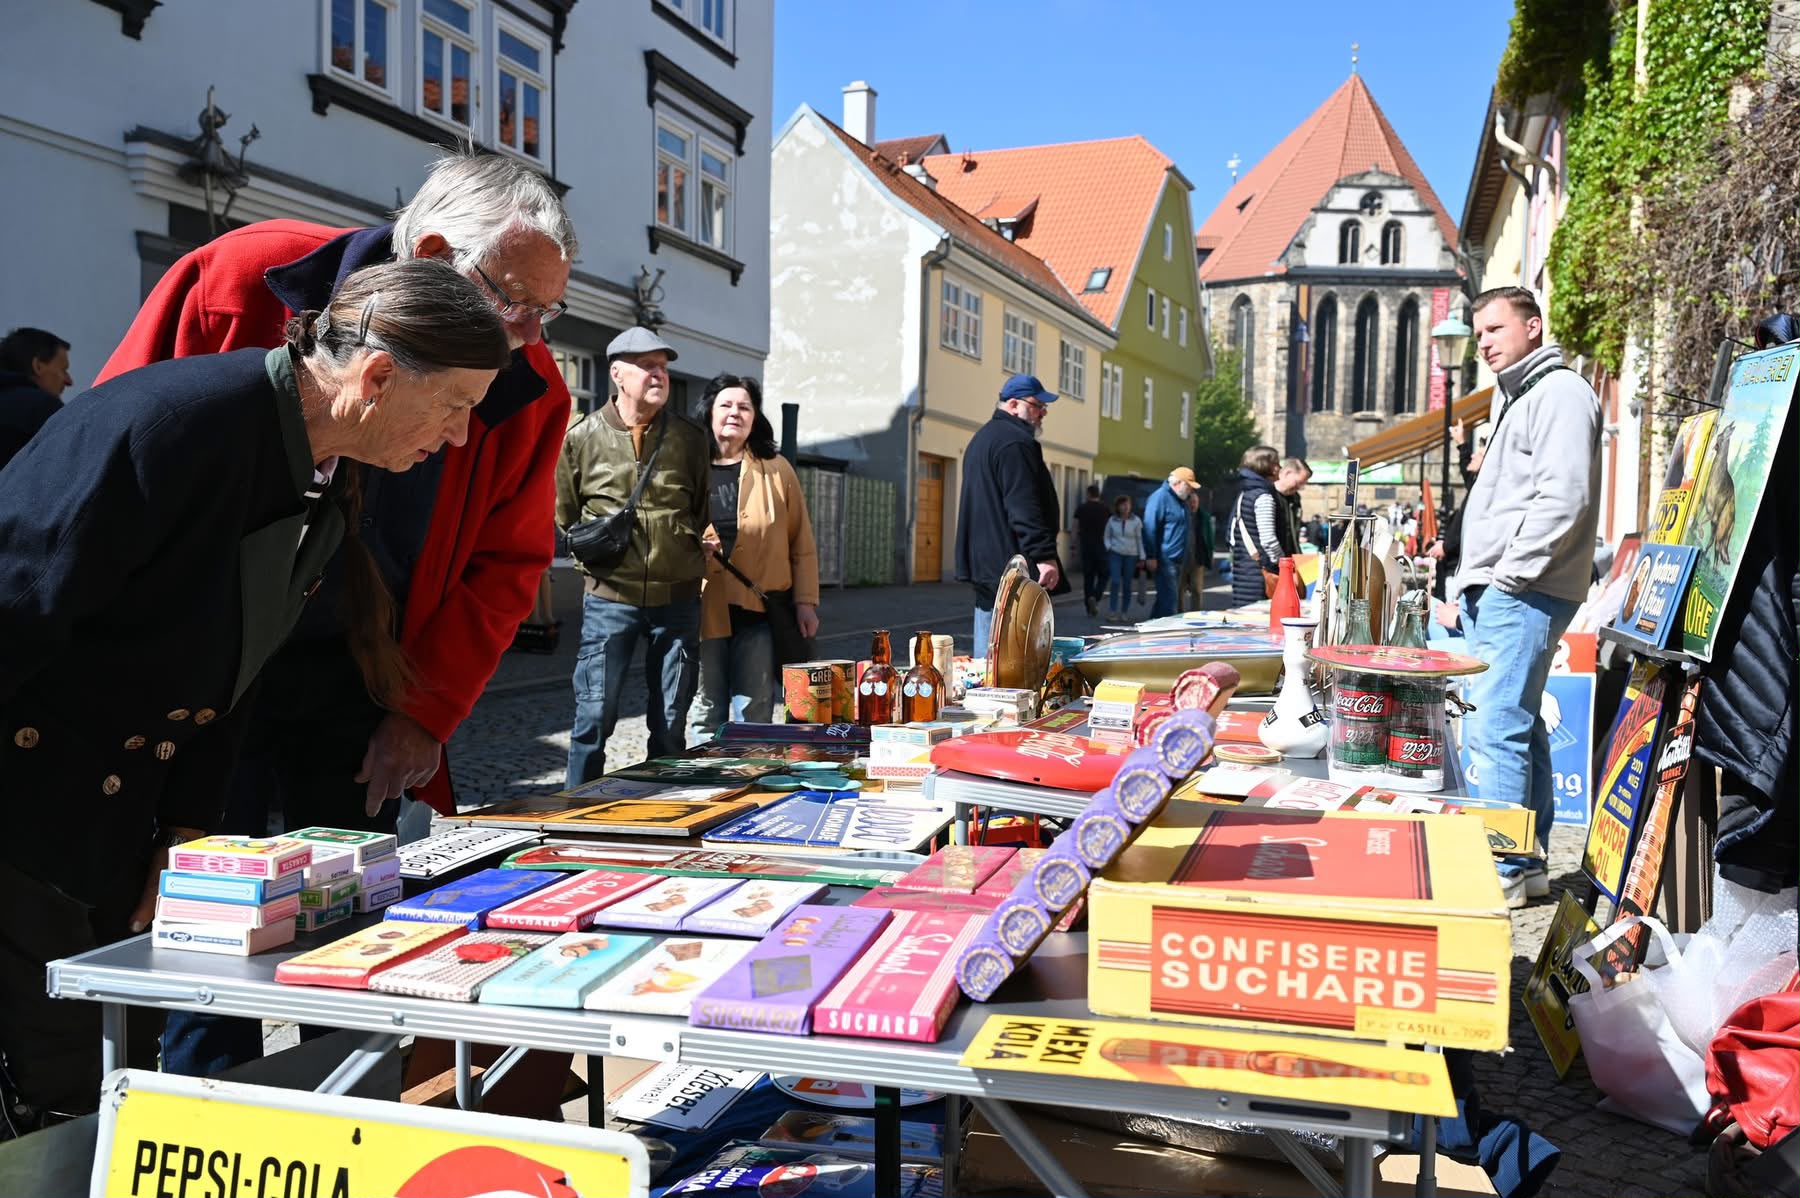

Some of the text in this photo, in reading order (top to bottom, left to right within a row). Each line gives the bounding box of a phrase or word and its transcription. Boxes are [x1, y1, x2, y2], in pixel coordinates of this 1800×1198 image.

[1597, 813, 1627, 858] MOTOR
[1594, 847, 1610, 882] OIL
[502, 916, 560, 928] SUCHARD
[875, 932, 954, 976] Suchard
[1160, 932, 1427, 978] CONFISERIE
[1160, 960, 1426, 1009] SUCHARD
[699, 1003, 799, 1032] SUCHARD
[828, 1009, 919, 1036] SUCHARD
[1397, 1022, 1447, 1036] CASTEL
[985, 1021, 1047, 1060] KOLA
[1039, 1025, 1096, 1065] MEXI
[665, 1069, 734, 1116] Kieser
